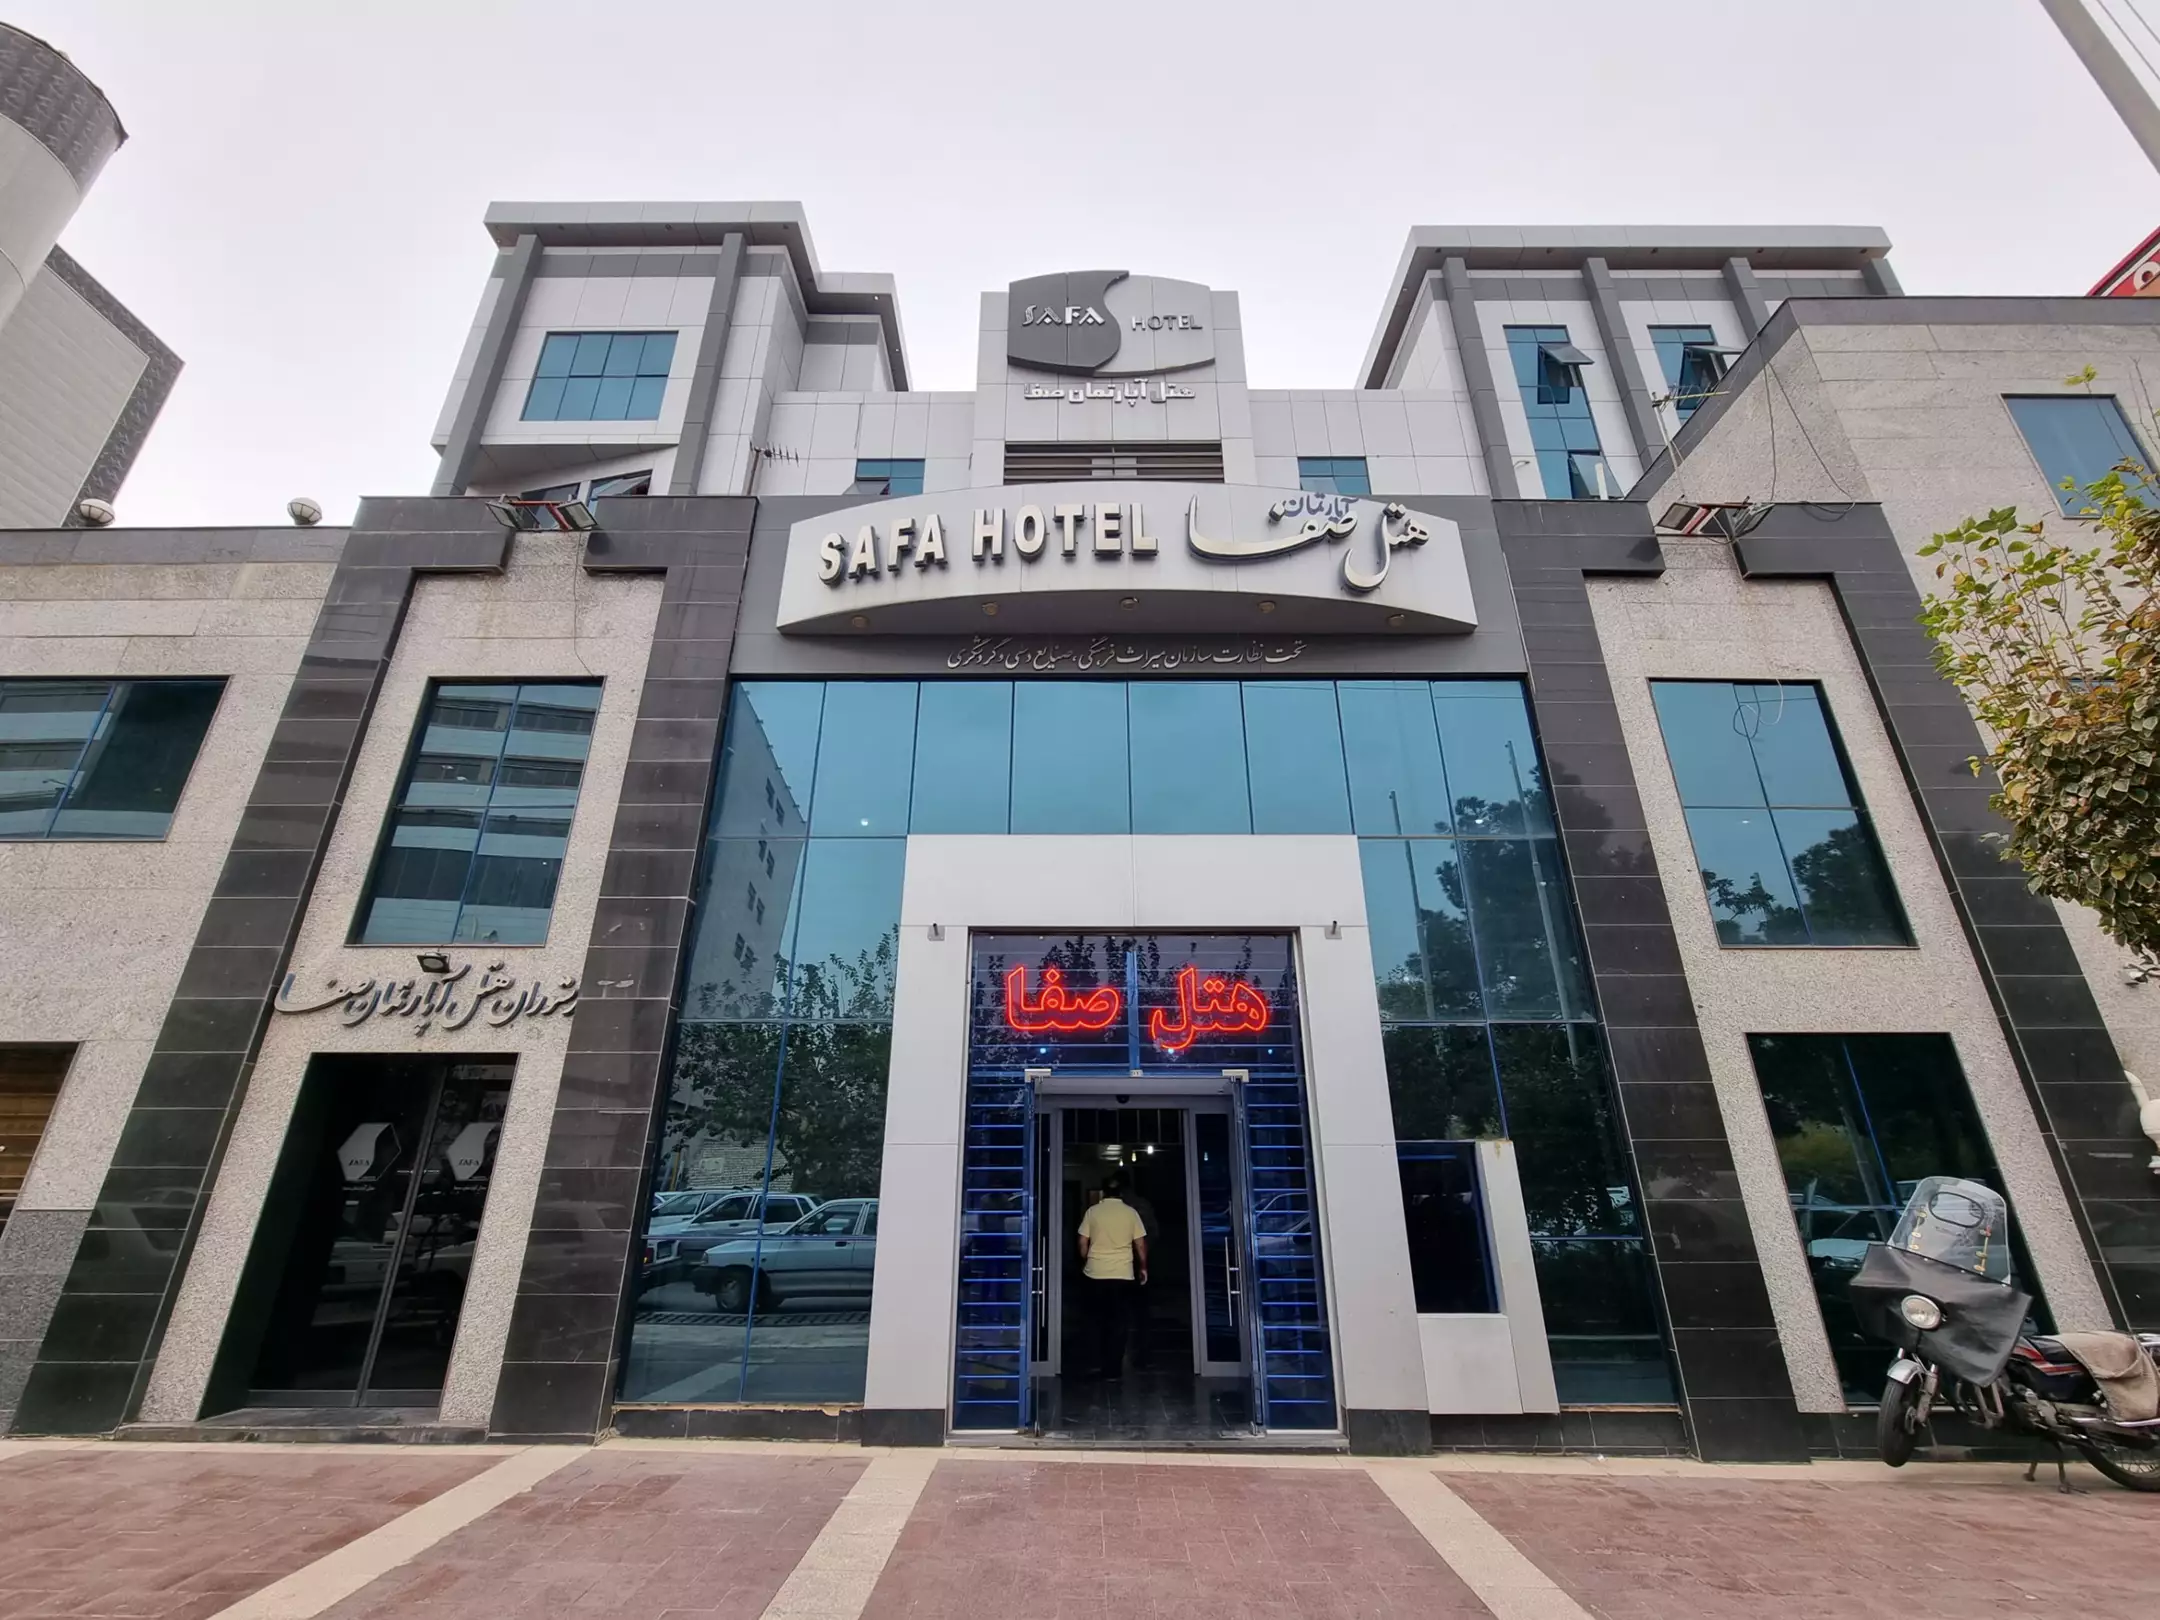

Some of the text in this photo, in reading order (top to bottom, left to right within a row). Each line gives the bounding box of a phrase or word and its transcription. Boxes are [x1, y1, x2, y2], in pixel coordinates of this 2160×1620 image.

[1022, 304, 1203, 330] SAFA HOTEL
[1024, 378, 1195, 407] هتل آپارتمان صفا
[817, 502, 1159, 587] SAFA HOTEL
[1188, 494, 1431, 592] هتل صفا
[1116, 645, 1166, 669] میراث
[1164, 645, 1212, 669] سازمان
[1212, 640, 1264, 664] نظارت
[1264, 639, 1308, 663] تحت
[274, 973, 376, 1014] صفا
[442, 961, 516, 1031] هتل
[1006, 966, 1268, 1050] هتل صفا
